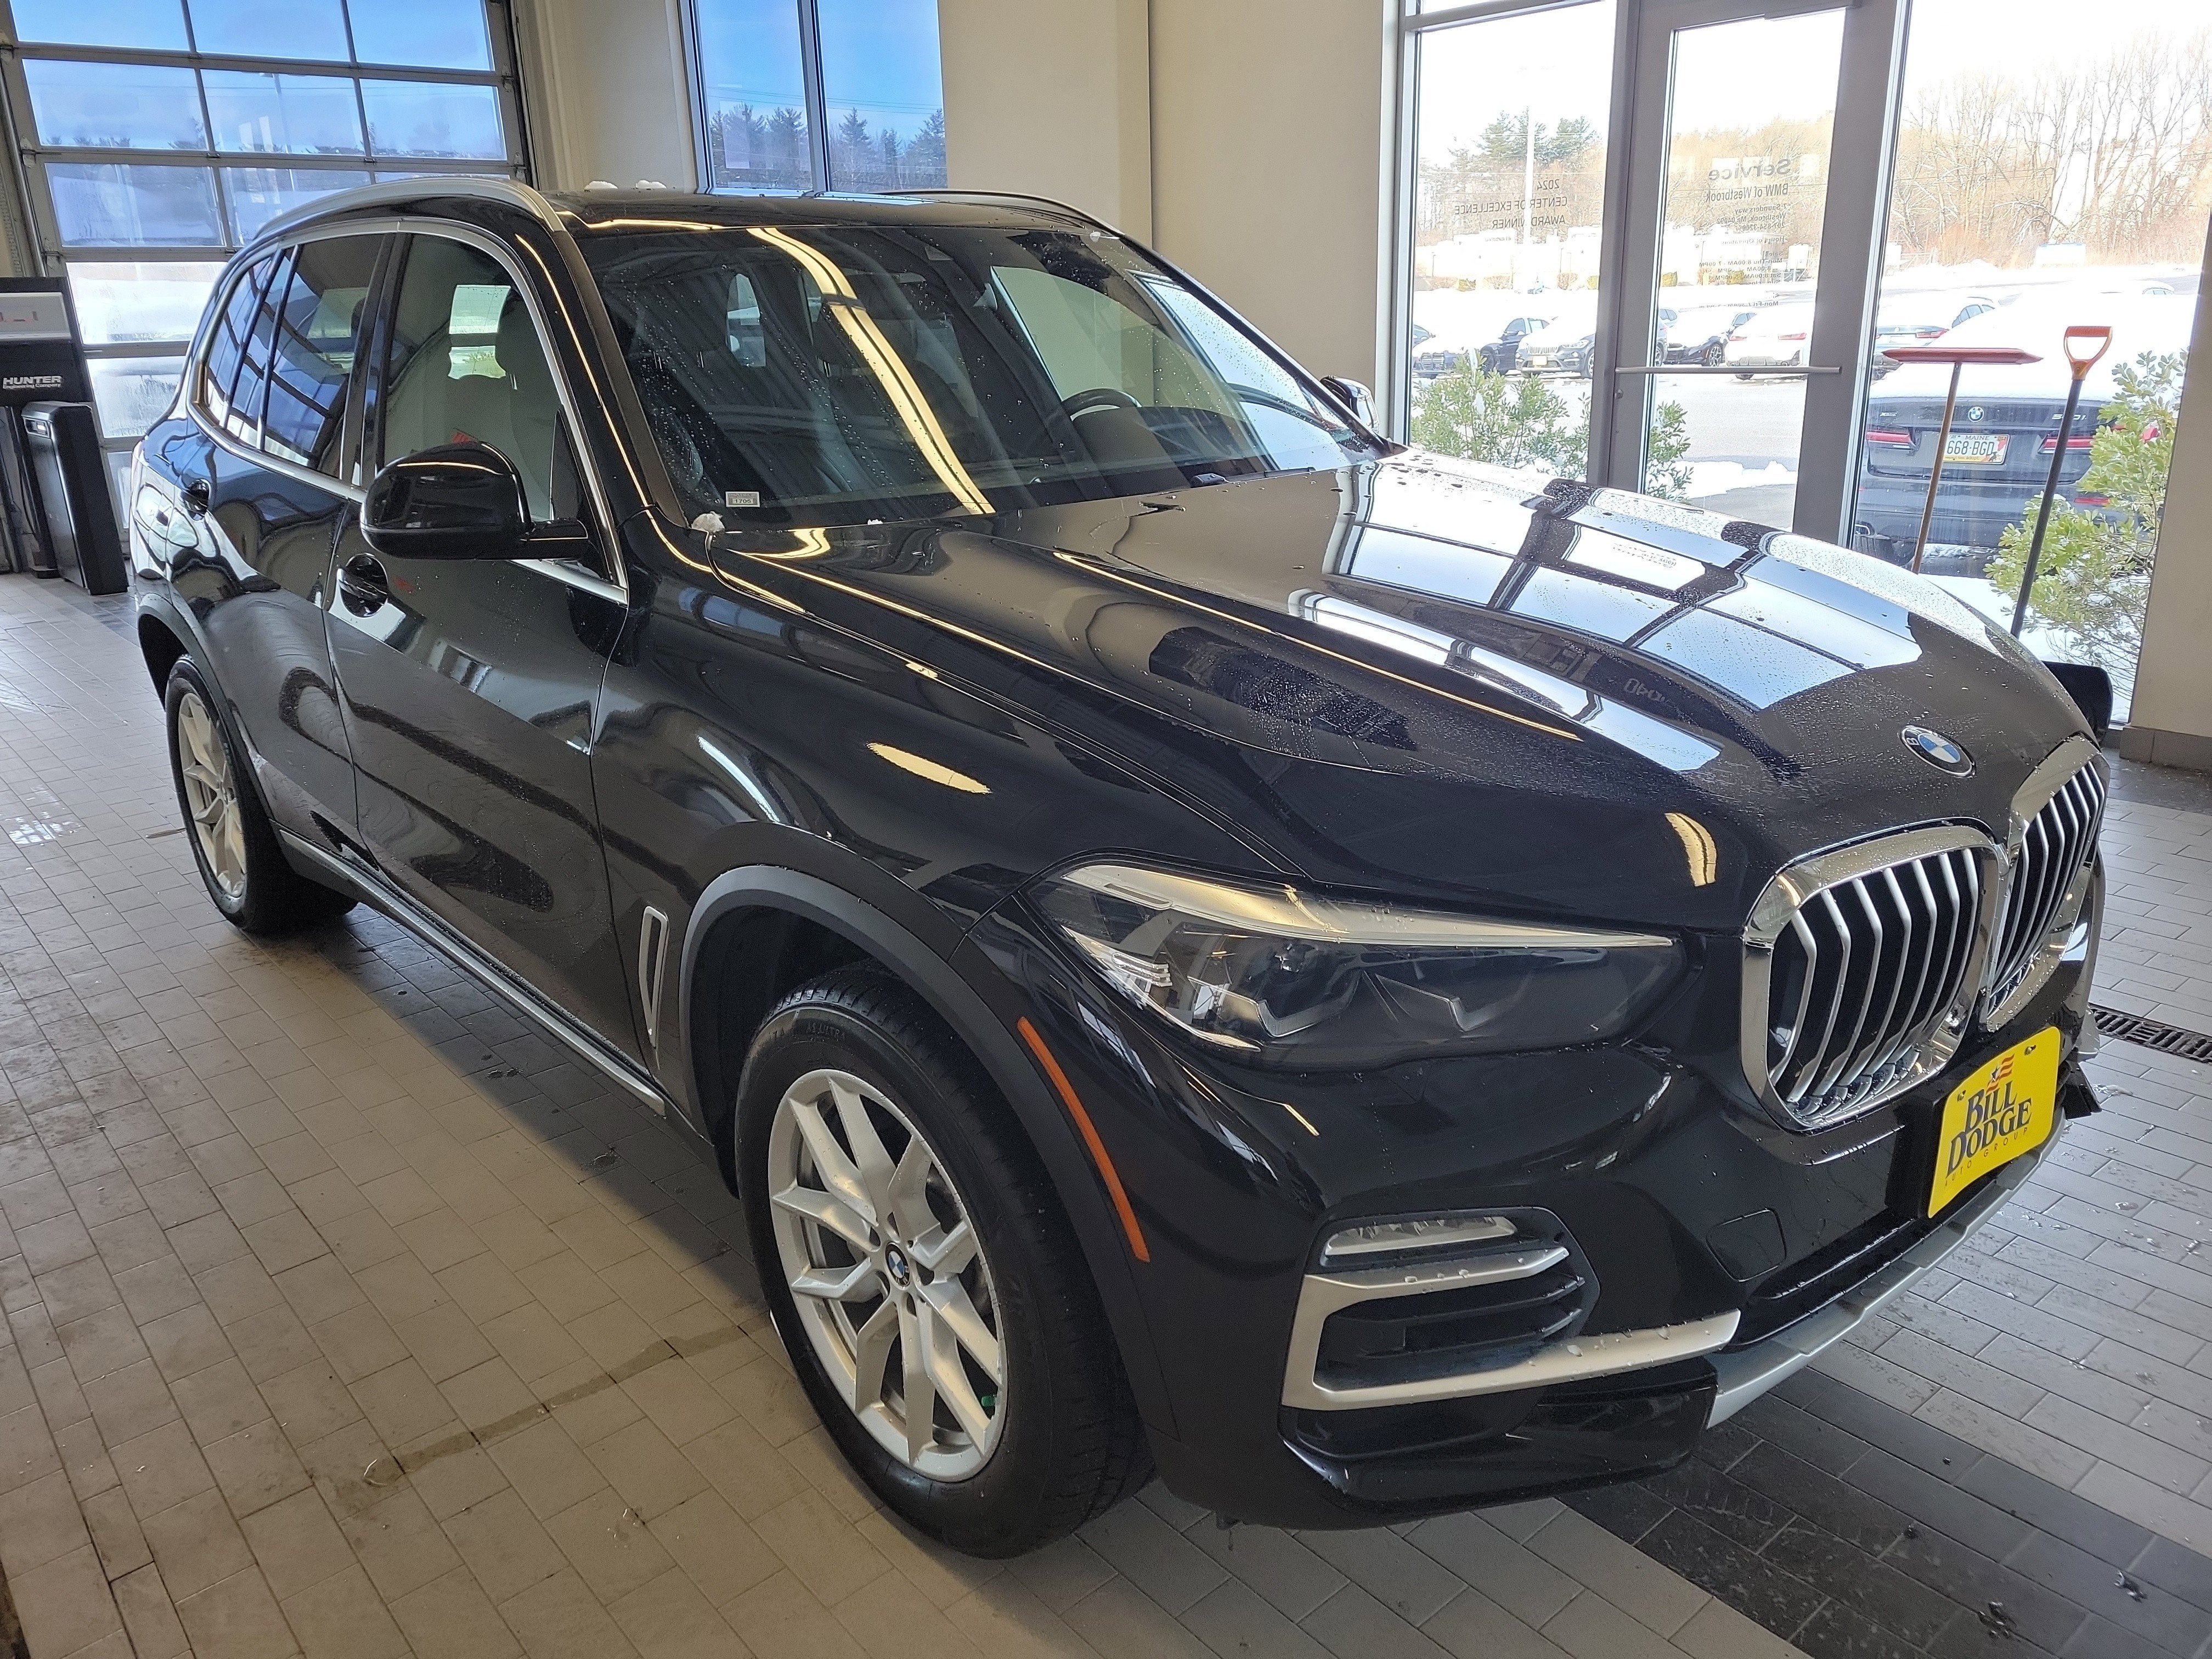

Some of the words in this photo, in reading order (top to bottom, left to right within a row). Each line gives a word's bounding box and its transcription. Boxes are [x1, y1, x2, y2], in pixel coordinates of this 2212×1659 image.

[3, 376, 62, 385] HUNTER
[1965, 1081, 2018, 1135] BILL
[1944, 1159, 1972, 1187] AUTO
[1983, 1126, 2029, 1158] GROUP
[1946, 1098, 2032, 1178] DODGE
